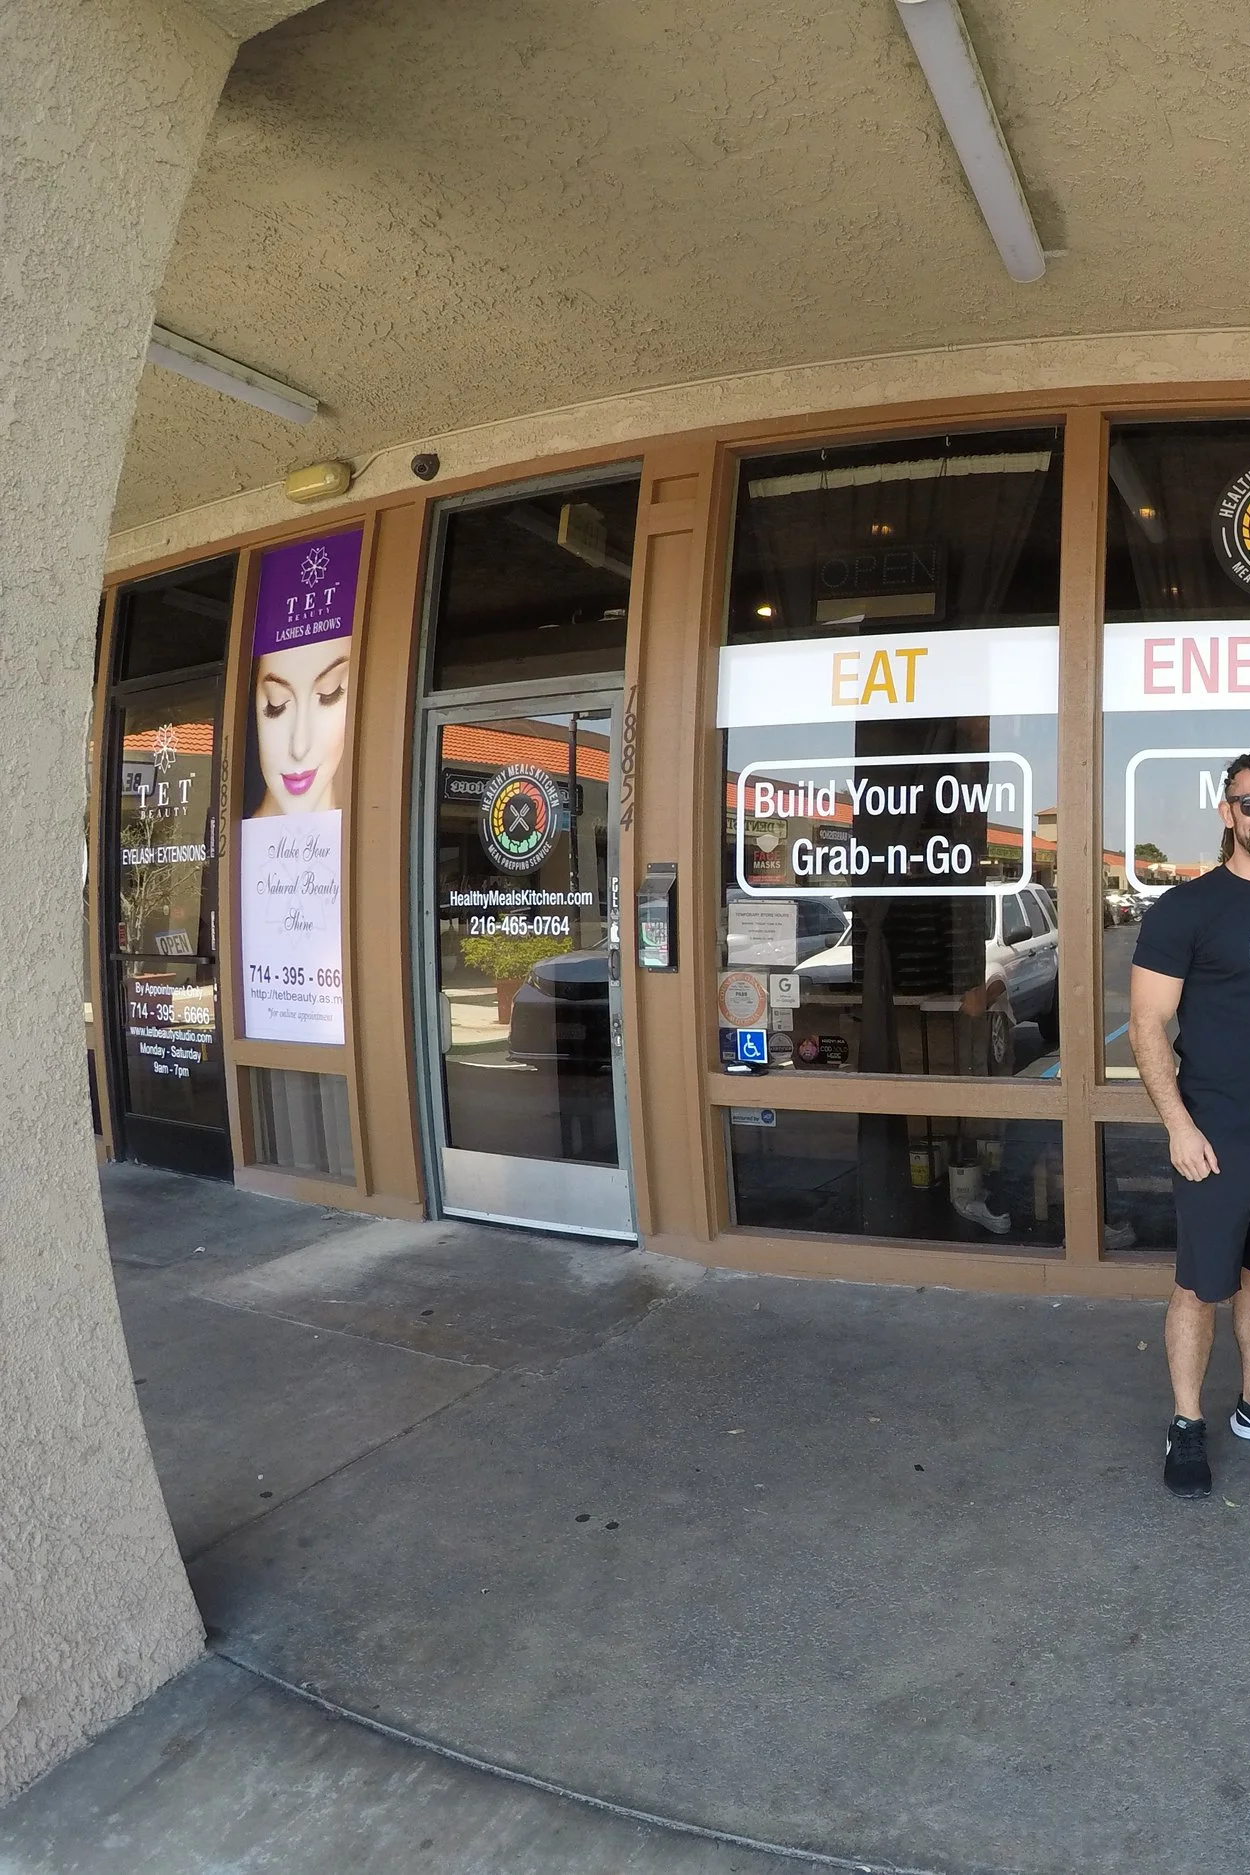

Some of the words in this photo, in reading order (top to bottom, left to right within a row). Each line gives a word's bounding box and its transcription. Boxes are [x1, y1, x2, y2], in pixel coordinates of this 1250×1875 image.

[820, 551, 937, 588] OPEN
[287, 587, 336, 614] TET
[288, 607, 331, 622] BEAUTY
[276, 625, 304, 642] LASHES
[305, 624, 311, 635] &
[313, 617, 341, 634] BROWS
[832, 648, 928, 706] EAT
[620, 685, 637, 831] 18854
[138, 779, 192, 808] TET
[219, 736, 229, 857] 18852
[482, 769, 508, 812] HEALTHY
[507, 764, 534, 776] MEALS
[535, 767, 560, 808] KITCHEN
[754, 780, 836, 818] Build
[846, 778, 923, 816] Your
[935, 775, 1015, 814] Own
[140, 807, 188, 820] BEAUTY
[122, 848, 154, 865] EYELASH
[157, 844, 206, 863] EXTENSIONS
[268, 836, 300, 858] Make
[303, 834, 330, 862] Your
[488, 844, 502, 864] MEAL
[500, 858, 530, 871] PREPPING
[530, 841, 552, 867] SERVICE
[754, 851, 780, 860] FACE
[792, 836, 972, 876] Grab-n-Go
[753, 861, 781, 869] MASKS
[257, 872, 300, 894] Natural
[301, 871, 339, 904] Beauty
[450, 889, 593, 909] HealthyMealsKitchen.com
[284, 908, 313, 931] Shine
[470, 916, 570, 936] 216-465-0764
[160, 935, 190, 954] OPEN
[250, 965, 271, 983] 714
[282, 966, 305, 985] 395
[135, 982, 144, 996] By
[145, 983, 185, 997] Appointment
[186, 985, 203, 1000] Only
[130, 1002, 148, 1018] 714
[156, 1004, 175, 1021] 395
[184, 1006, 209, 1024] 6666
[130, 1026, 212, 1043] www.tetbeautystudio.com
[140, 1042, 166, 1058] Monday
[171, 1046, 201, 1063] Saturday
[154, 1061, 168, 1074] 9am
[174, 1064, 189, 1078] 7pm
